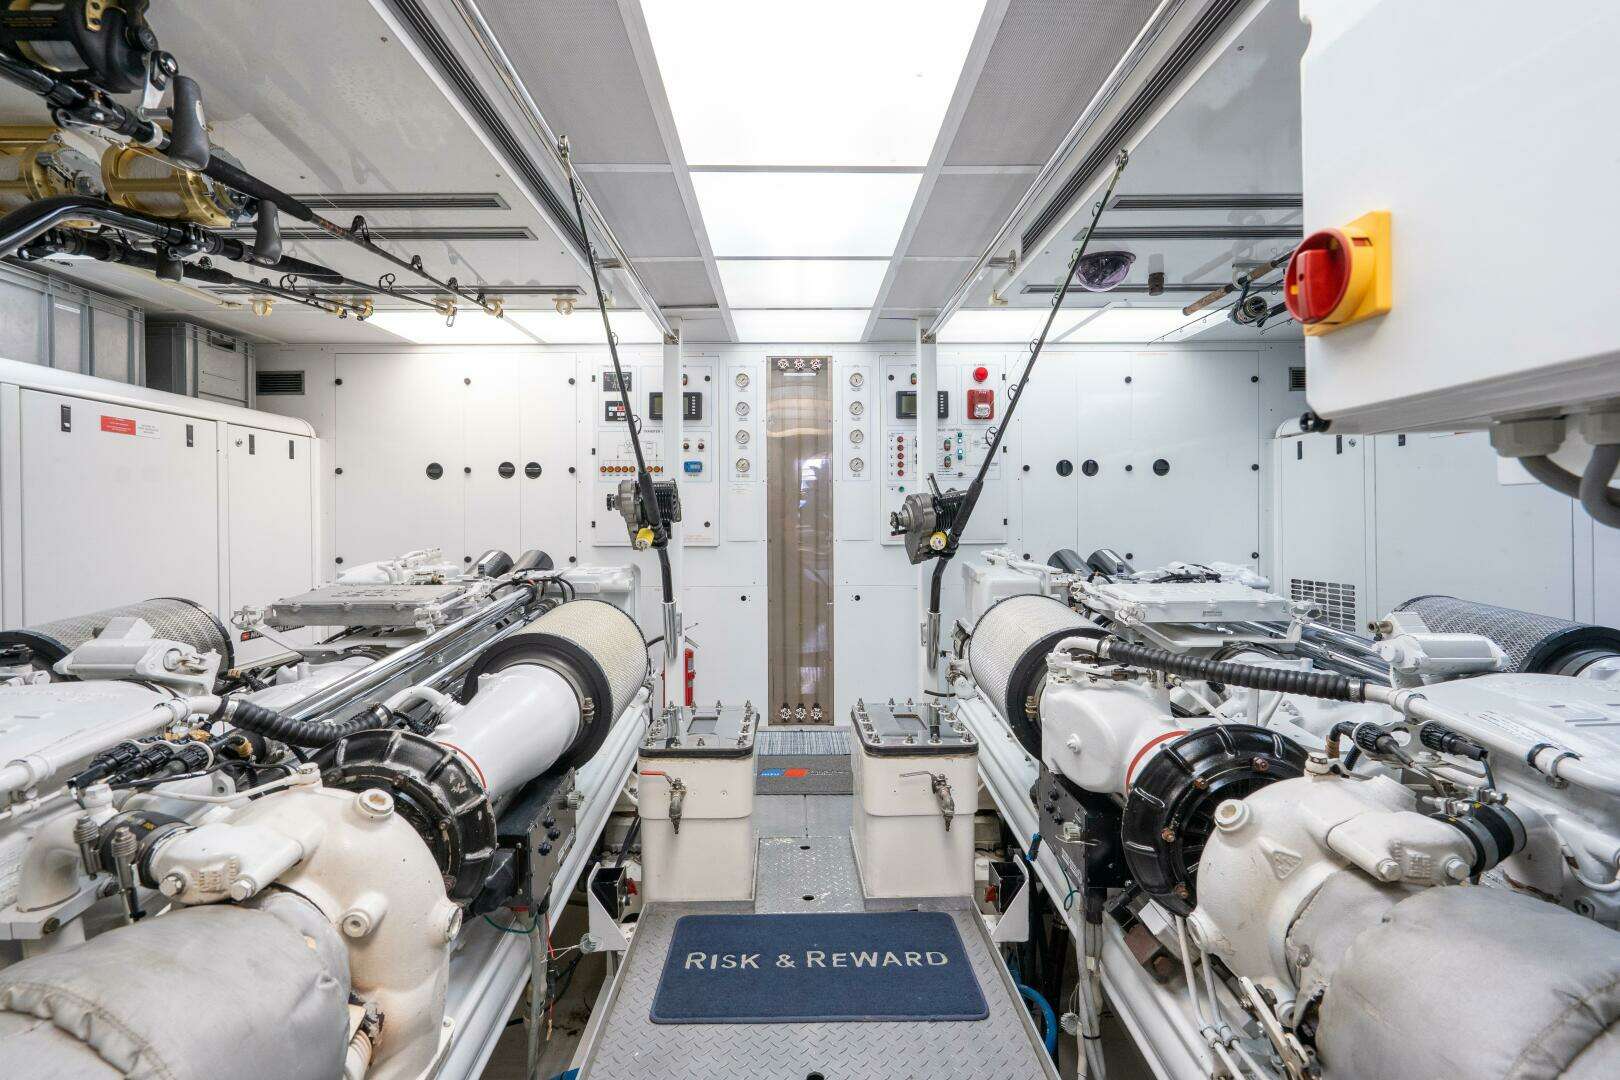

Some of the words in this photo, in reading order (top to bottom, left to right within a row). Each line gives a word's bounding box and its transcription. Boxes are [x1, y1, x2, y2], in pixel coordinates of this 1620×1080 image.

[684, 951, 761, 970] RISK
[775, 953, 796, 969] &
[805, 950, 949, 968] REWARD
